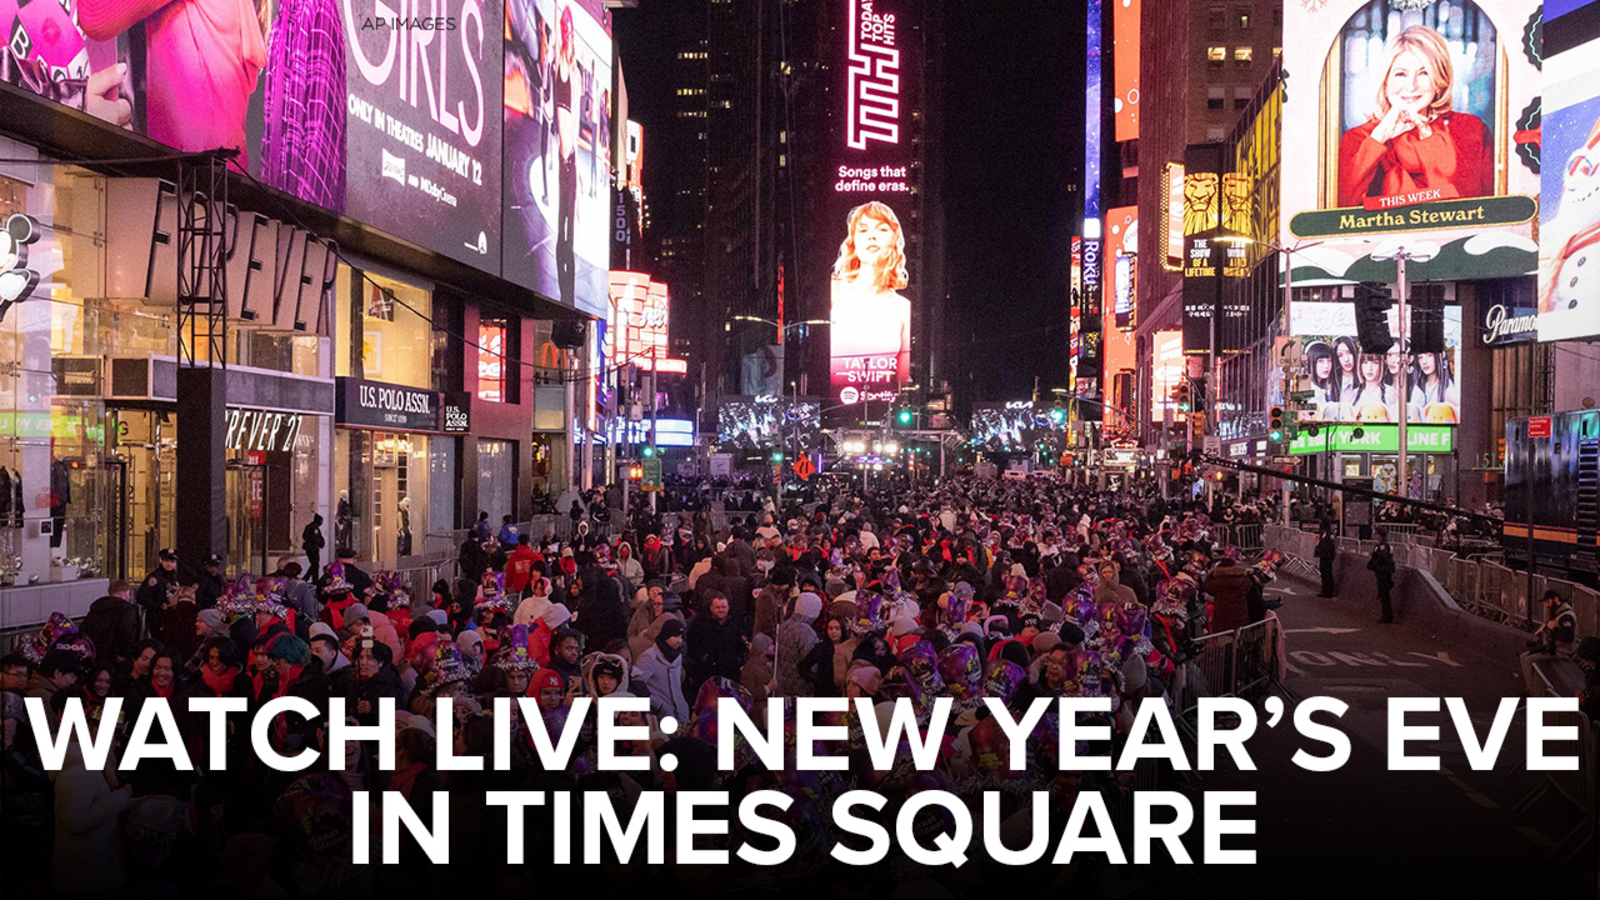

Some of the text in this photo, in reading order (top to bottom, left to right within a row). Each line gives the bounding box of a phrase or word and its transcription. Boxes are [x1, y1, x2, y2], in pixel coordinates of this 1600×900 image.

[872, 14, 884, 42] TOP
[883, 13, 895, 46] HITS
[344, 0, 485, 147] GIRLS
[348, 93, 374, 124] ONLY
[374, 107, 386, 132] IN
[386, 114, 424, 153] THEATRES
[425, 132, 470, 178] JANUARY
[472, 159, 482, 186] 12
[838, 165, 906, 179] Songs that
[835, 180, 909, 192] define eras.
[1379, 188, 1441, 208] THIS WEEK
[1338, 205, 1485, 230] Martha Stewart
[1190, 248, 1211, 258] SHOW
[1194, 239, 1208, 249] THE
[1185, 267, 1216, 277] LIFETIME
[843, 357, 897, 369] TAYLOR
[847, 371, 893, 382] SWIFT
[360, 385, 430, 414] U.S. POLO ASSN.
[446, 413, 468, 421] POLO
[225, 410, 303, 452] REVER 21
[1289, 650, 1463, 668] ONLY
